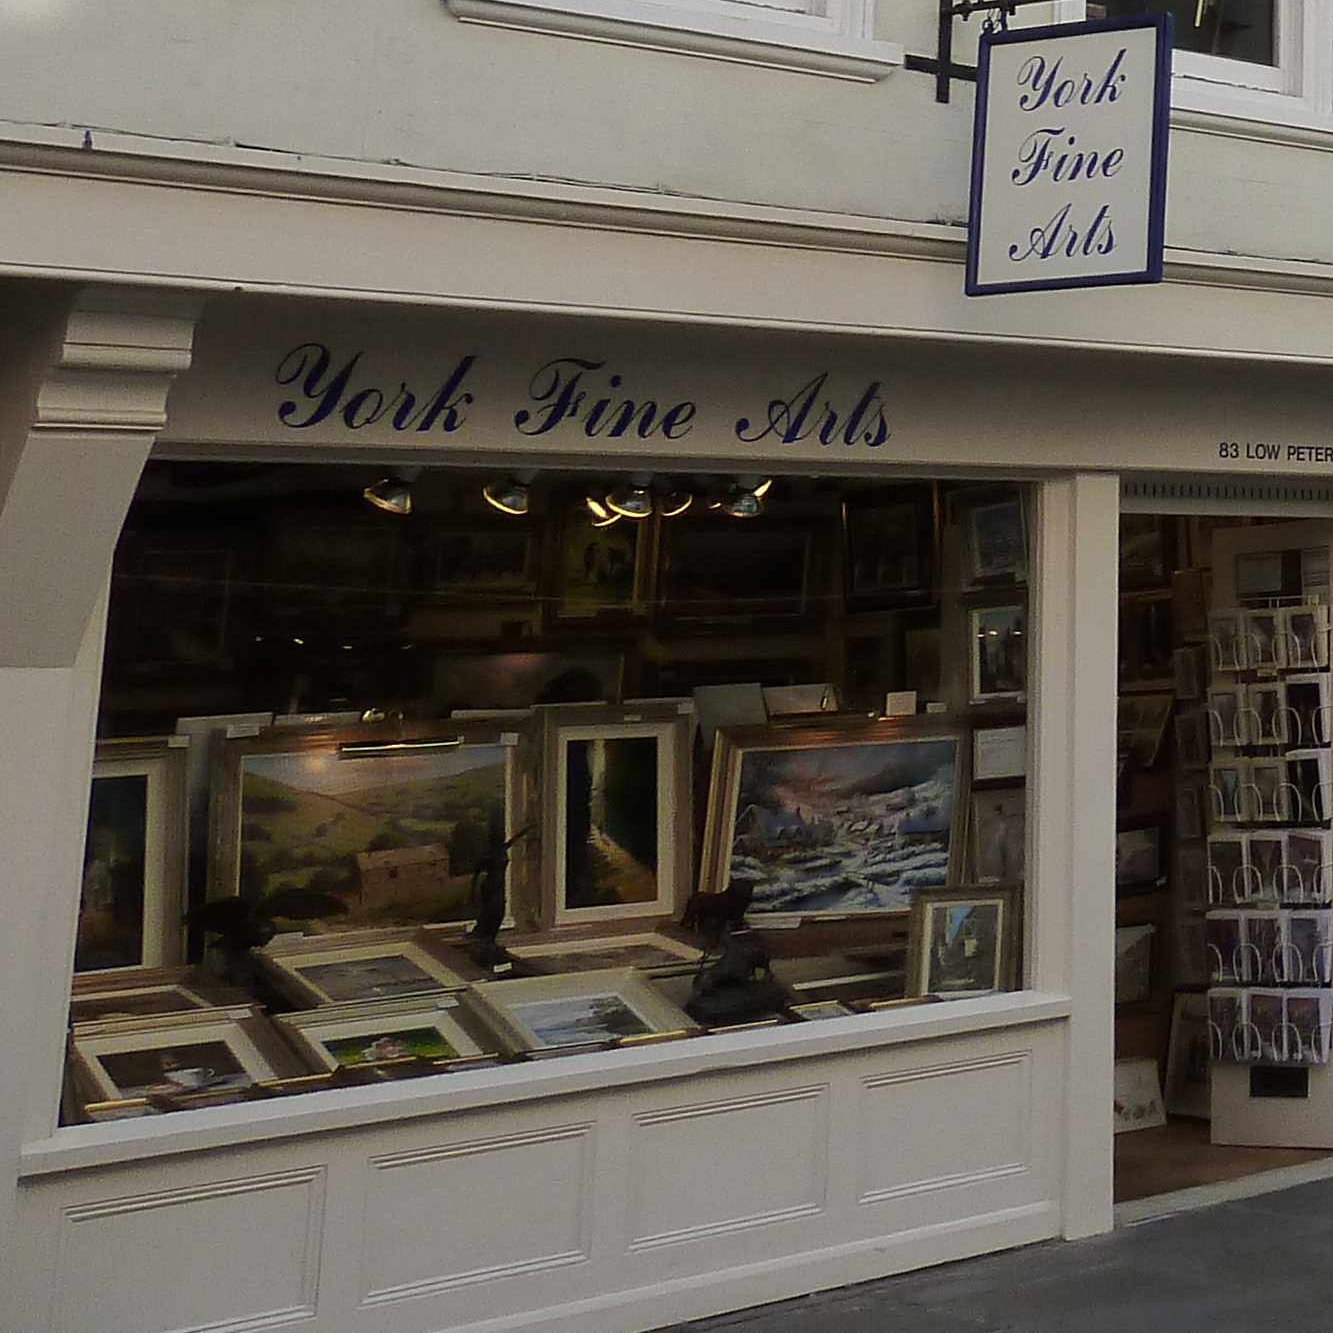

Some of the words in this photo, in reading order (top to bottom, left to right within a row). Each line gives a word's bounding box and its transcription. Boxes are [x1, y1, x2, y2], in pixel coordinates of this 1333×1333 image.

[1016, 48, 1127, 112] York
[1011, 127, 1125, 186] Fine
[1008, 203, 1117, 262] Arts
[275, 343, 476, 431] York
[513, 356, 698, 440] Fine
[736, 372, 893, 448] Arts
[1218, 442, 1240, 459] 83
[1246, 443, 1280, 460] LOW
